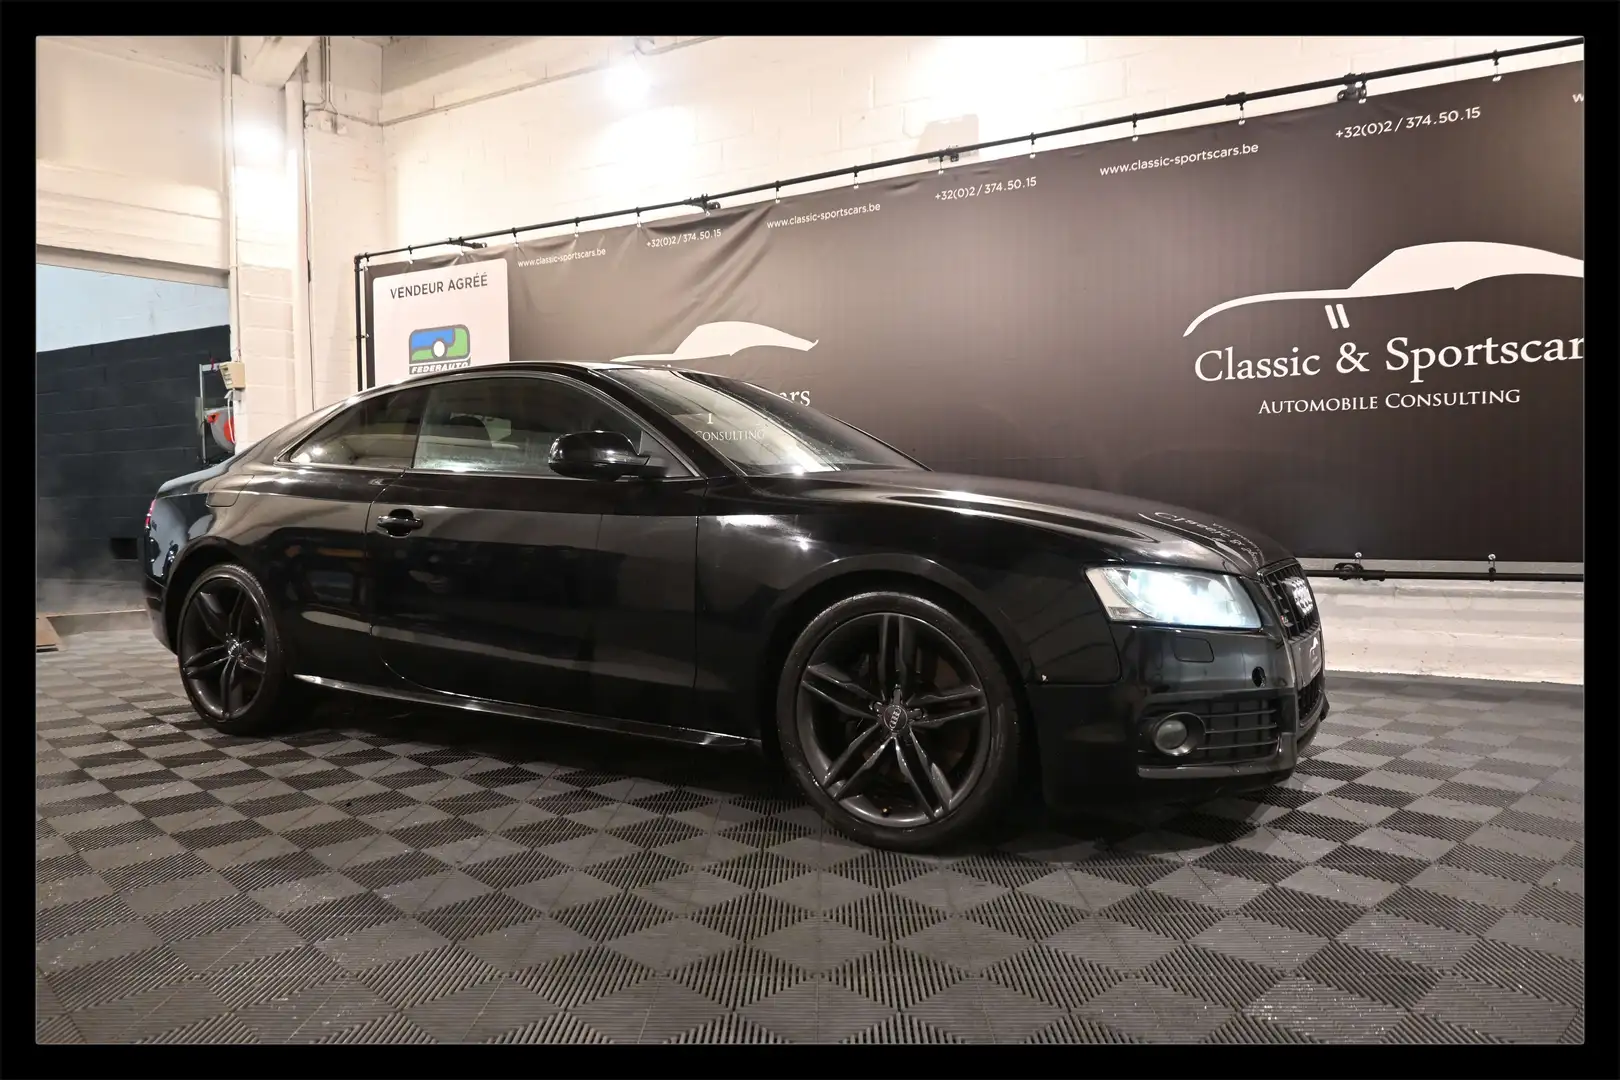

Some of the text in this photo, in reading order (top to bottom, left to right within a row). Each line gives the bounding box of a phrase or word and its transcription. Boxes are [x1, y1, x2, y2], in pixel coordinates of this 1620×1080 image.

[1335, 120, 1392, 139] +32(0)2
[1405, 106, 1481, 129] 374.50.15
[1099, 143, 1259, 176] www.classic-sportscars.be
[934, 185, 976, 201] +32(0)2
[766, 202, 881, 229] www.classic-sportscars.be
[517, 247, 607, 268] www.classic-sportscars.be
[390, 271, 488, 299] VENDEUR AGRÉÉ
[411, 361, 469, 374] FEDERAUTO
[1194, 346, 1321, 382] Classic
[1335, 342, 1371, 374] &
